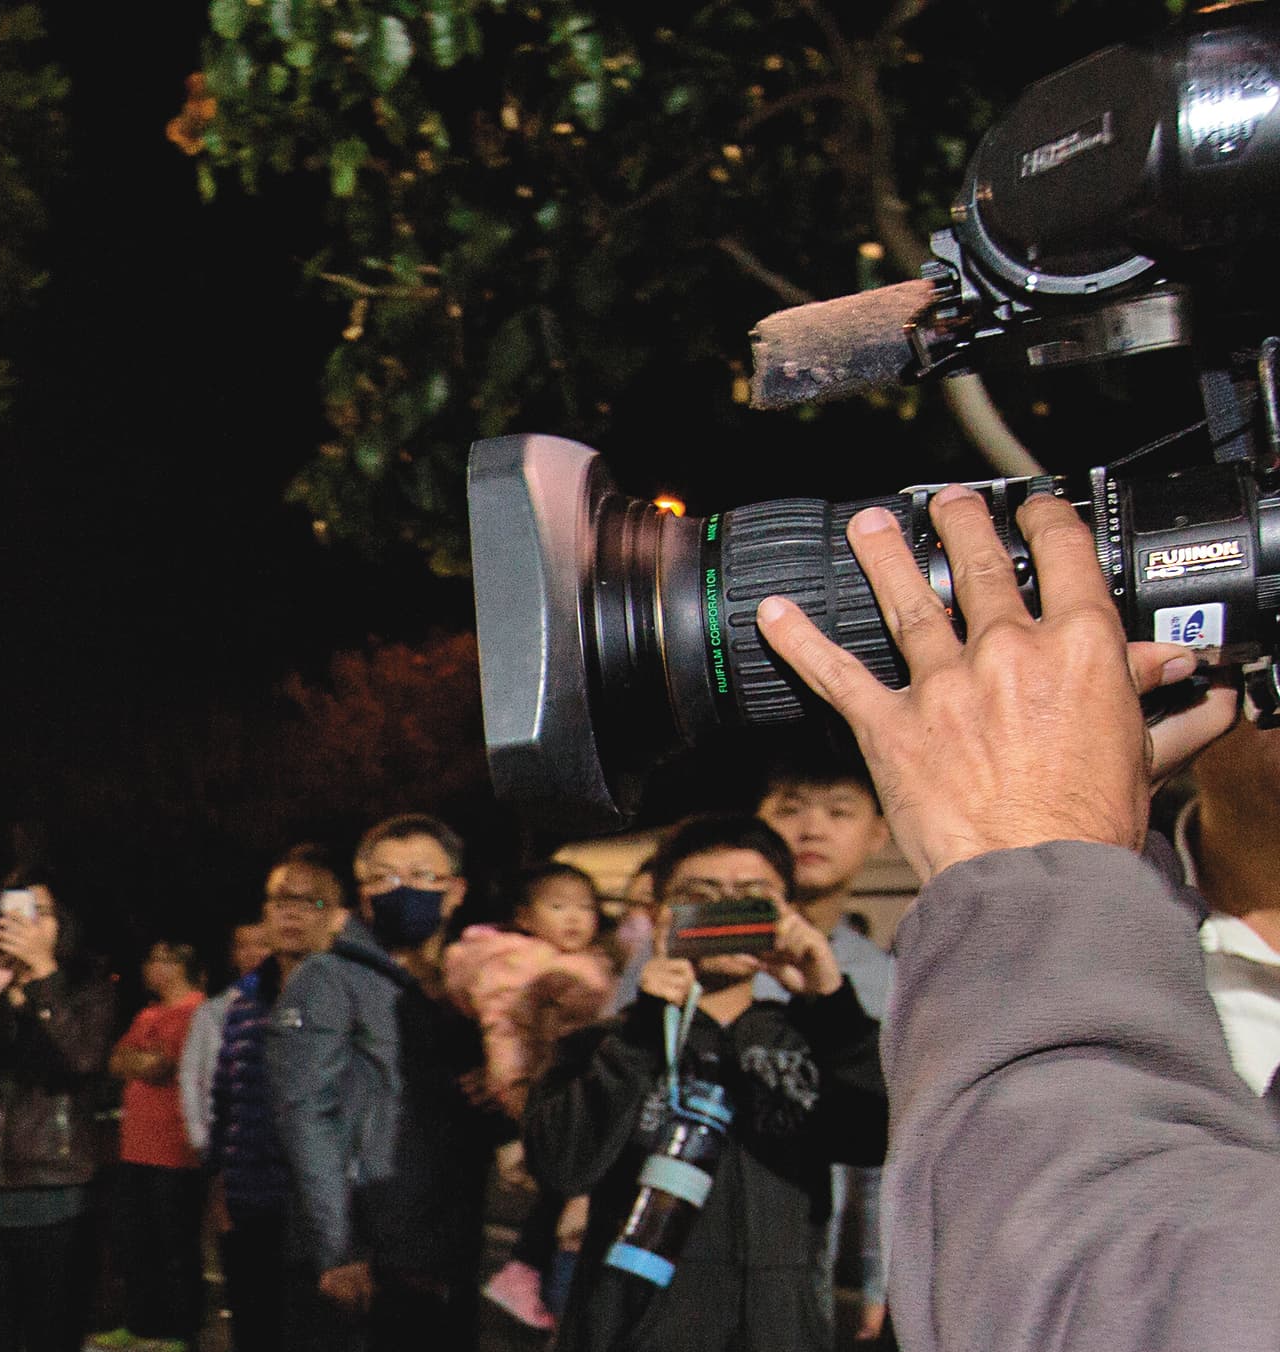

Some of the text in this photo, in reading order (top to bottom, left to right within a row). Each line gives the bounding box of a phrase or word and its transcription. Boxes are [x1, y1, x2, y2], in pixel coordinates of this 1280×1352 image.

[1148, 541, 1239, 567] FUJINON
[706, 569, 728, 693] FUJIFILM CORPORATION
